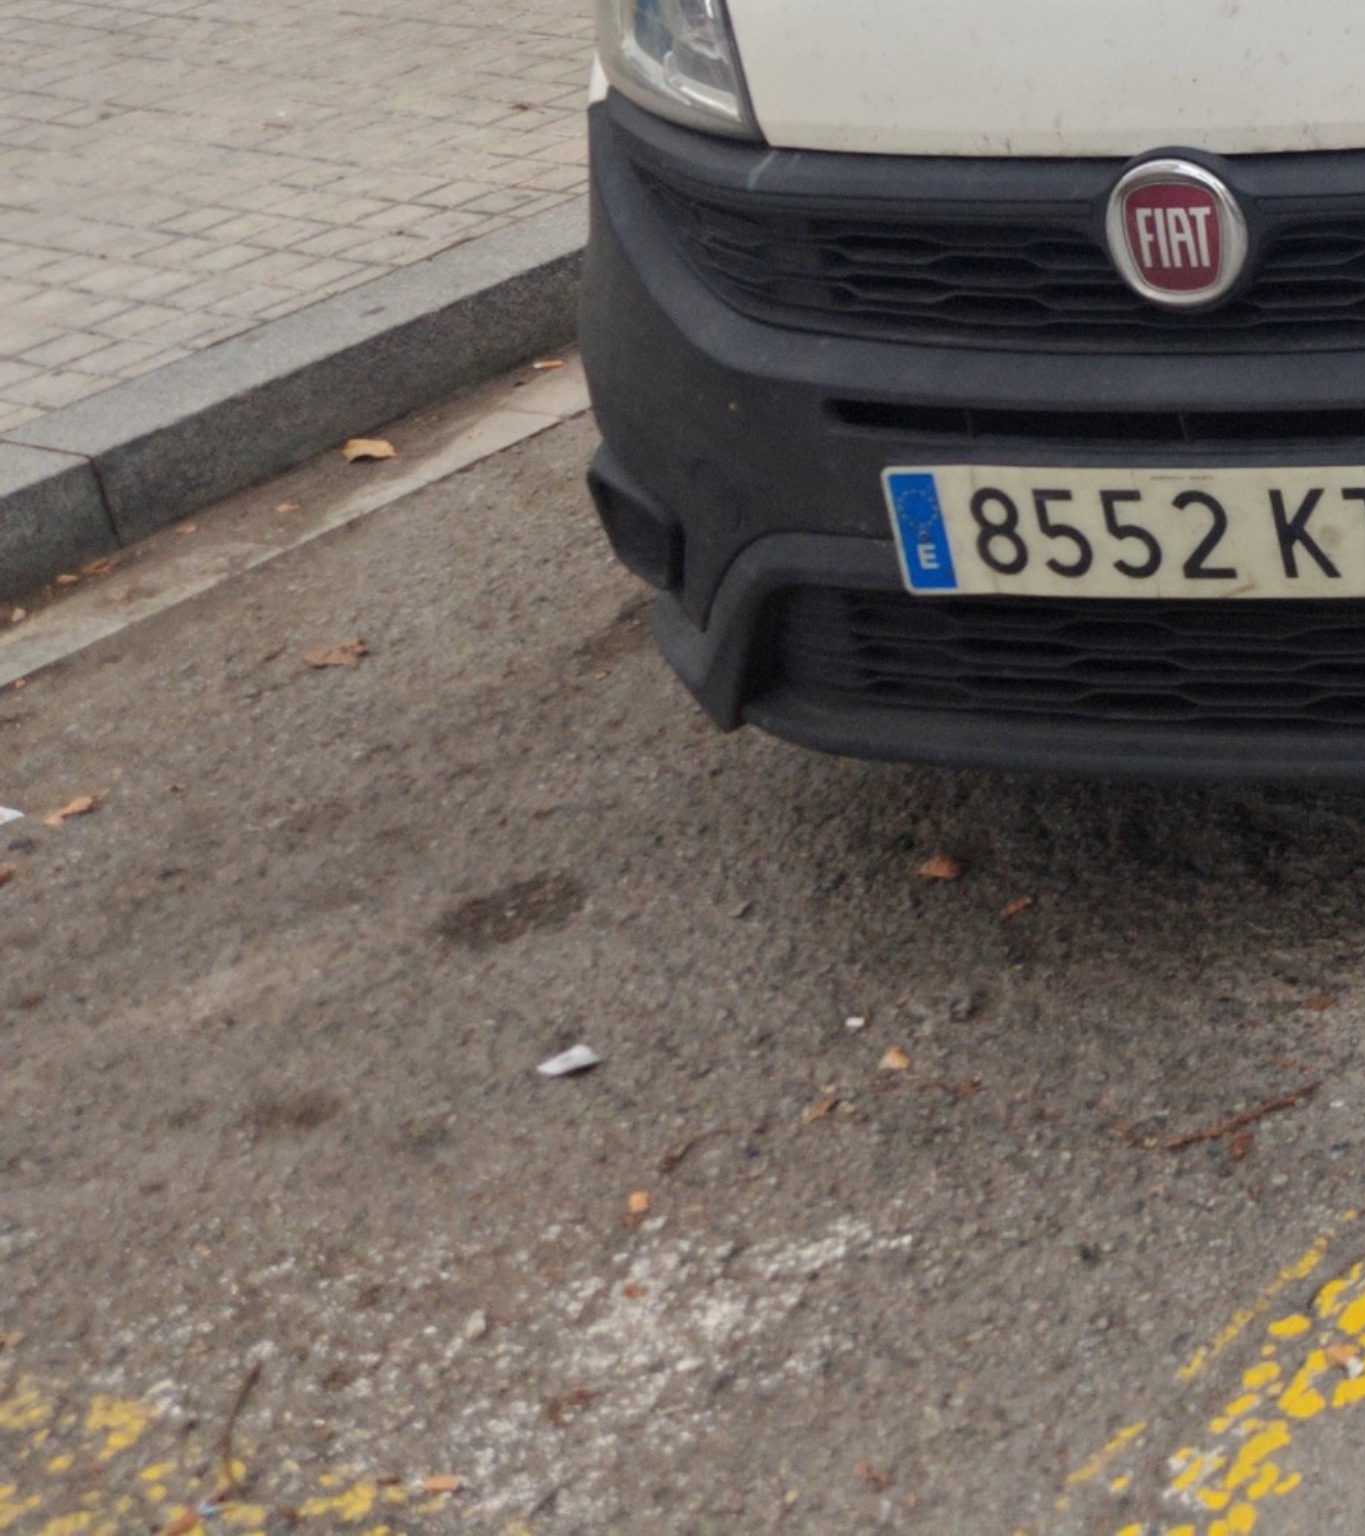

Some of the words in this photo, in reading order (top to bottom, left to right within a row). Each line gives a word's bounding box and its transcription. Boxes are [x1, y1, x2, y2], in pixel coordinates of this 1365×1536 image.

[1136, 207, 1213, 268] FIAT
[916, 544, 937, 570] E
[969, 486, 1237, 581] 8552
